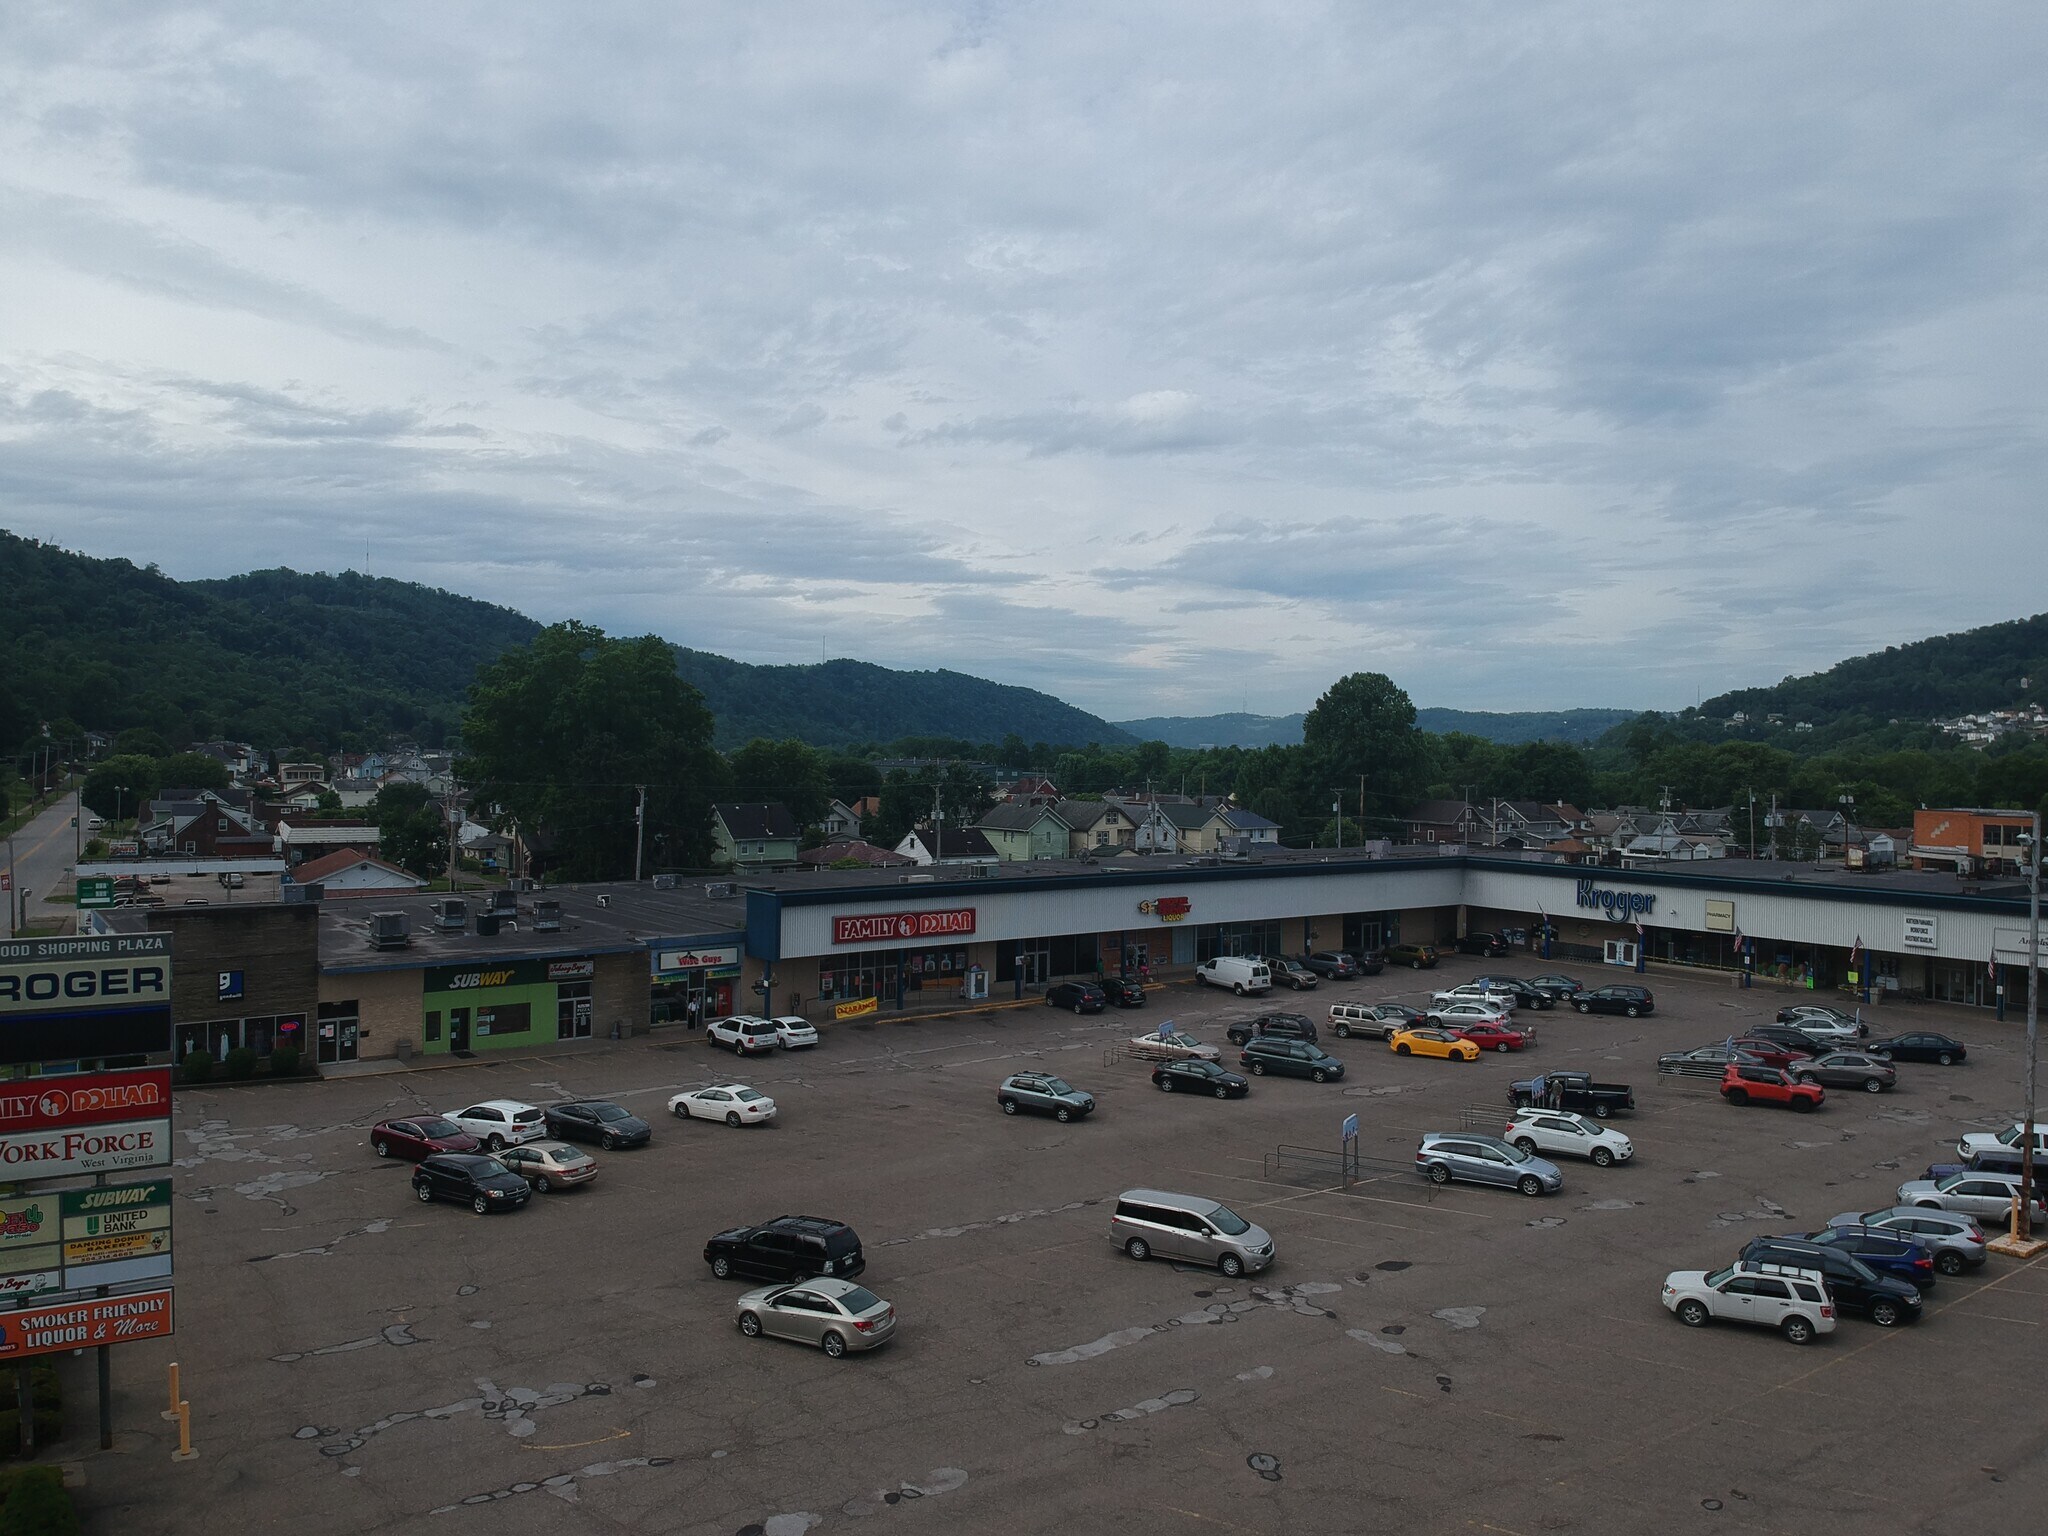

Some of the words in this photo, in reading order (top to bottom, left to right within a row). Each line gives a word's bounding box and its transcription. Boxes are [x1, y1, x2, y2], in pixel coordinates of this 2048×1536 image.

[1577, 878, 1655, 924] Kroger
[839, 917, 897, 940] FAMILY
[920, 911, 972, 933] DOLLAR
[0, 945, 30, 958] OOD
[38, 940, 110, 955] SHOPPING
[118, 938, 164, 951] PLAZA
[679, 957, 699, 966] Wise
[702, 955, 722, 964] Guys
[449, 970, 516, 989] SUBWAY
[0, 1095, 38, 1119] ILY
[72, 1083, 159, 1112] DOLLAR
[81, 1159, 106, 1168] West
[112, 1153, 154, 1166] Virginia
[80, 1185, 156, 1209] SUBWAY
[104, 1210, 148, 1224] UNITED
[104, 1221, 136, 1233] BANK
[70, 1239, 112, 1250] DANCING
[114, 1234, 145, 1243] DONUT
[87, 1242, 133, 1252] BAKERY
[4, 1278, 31, 1291] Boys
[20, 1309, 88, 1331] SMOKER
[93, 1298, 165, 1320] FRIENDLY
[27, 1326, 88, 1348] LIQUOR
[93, 1322, 106, 1340] &
[113, 1318, 159, 1336] More
